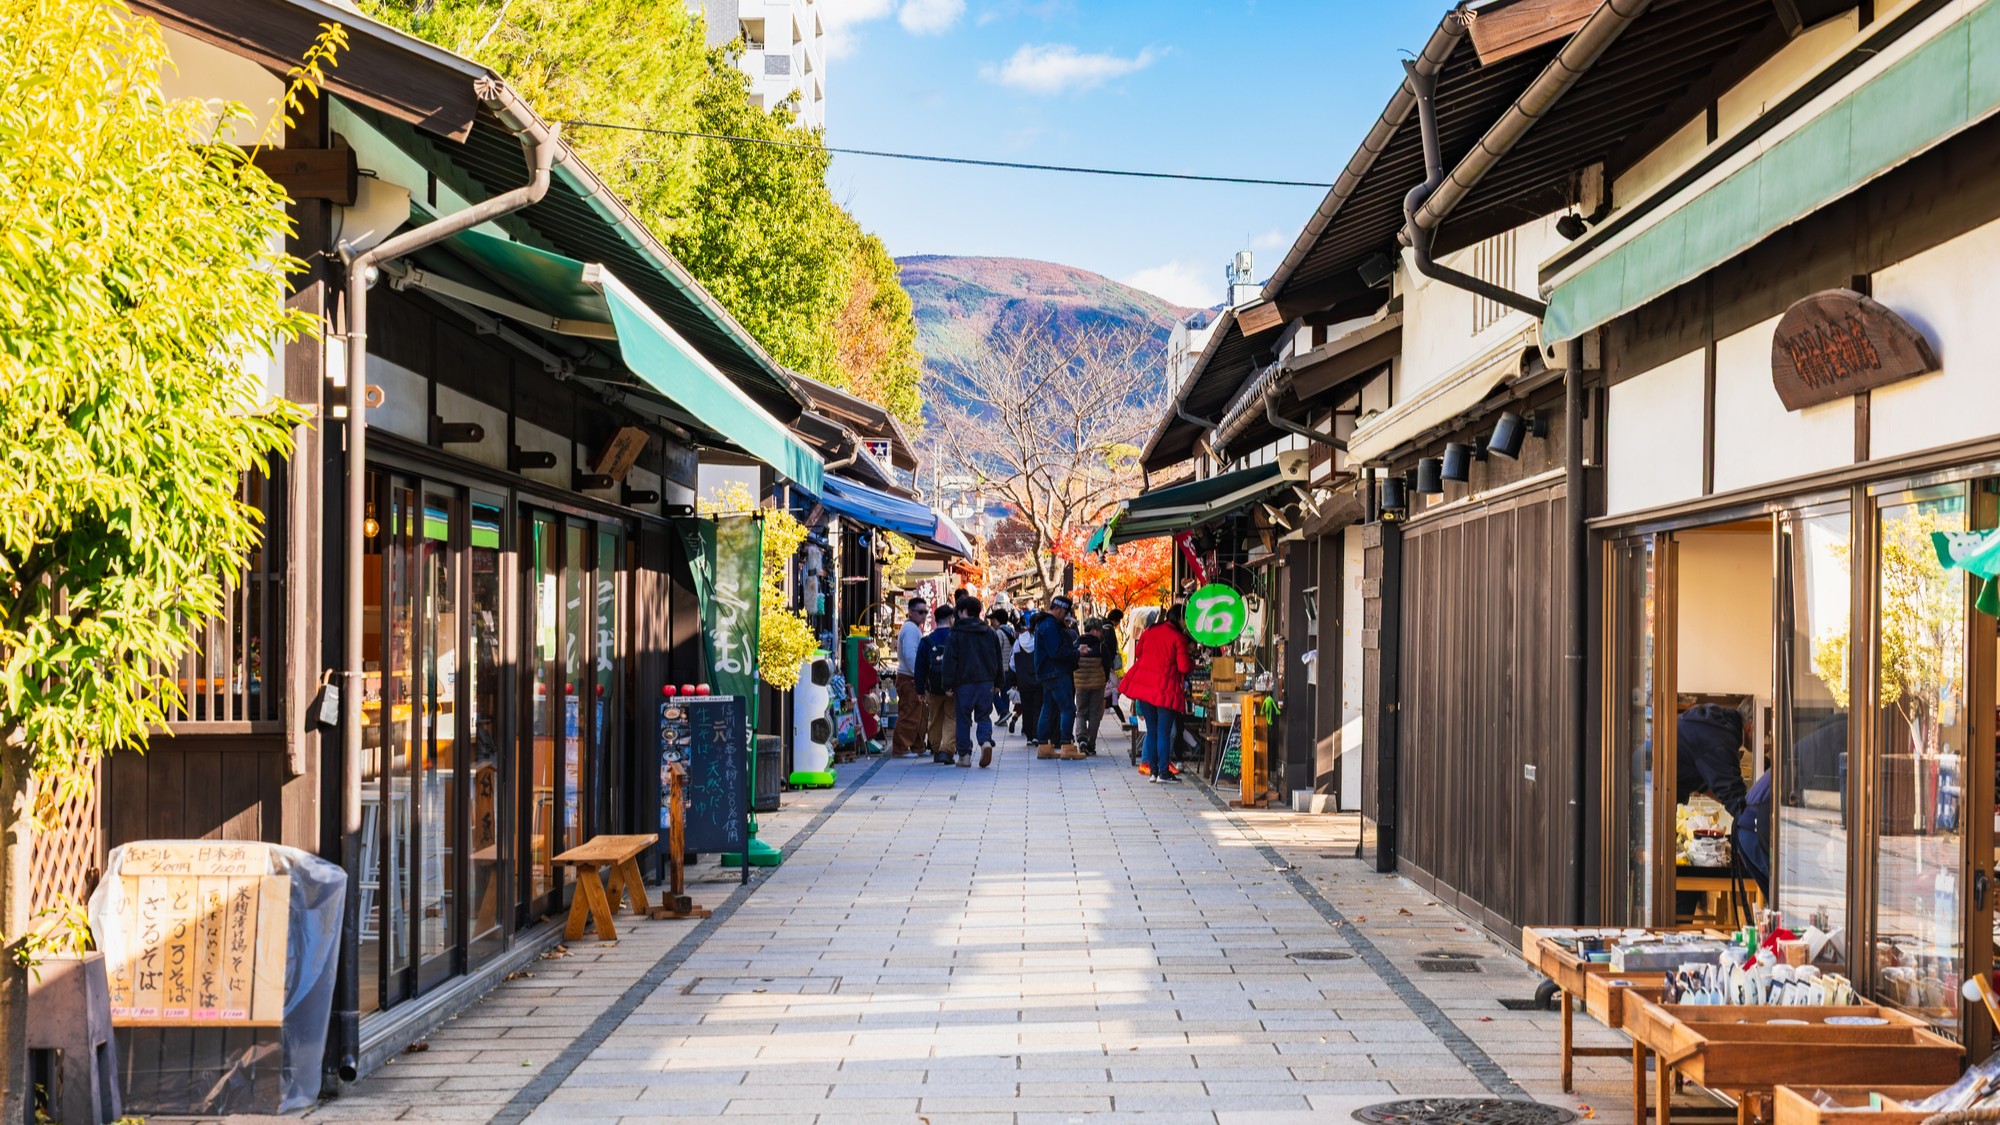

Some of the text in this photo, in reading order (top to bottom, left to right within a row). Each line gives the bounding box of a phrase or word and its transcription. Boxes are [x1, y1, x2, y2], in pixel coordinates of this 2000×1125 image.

[713, 720, 728, 743] 二八
[199, 846, 246, 862] 日本酒
[140, 896, 165, 991] ざるそば
[169, 891, 192, 1003] とろろそば
